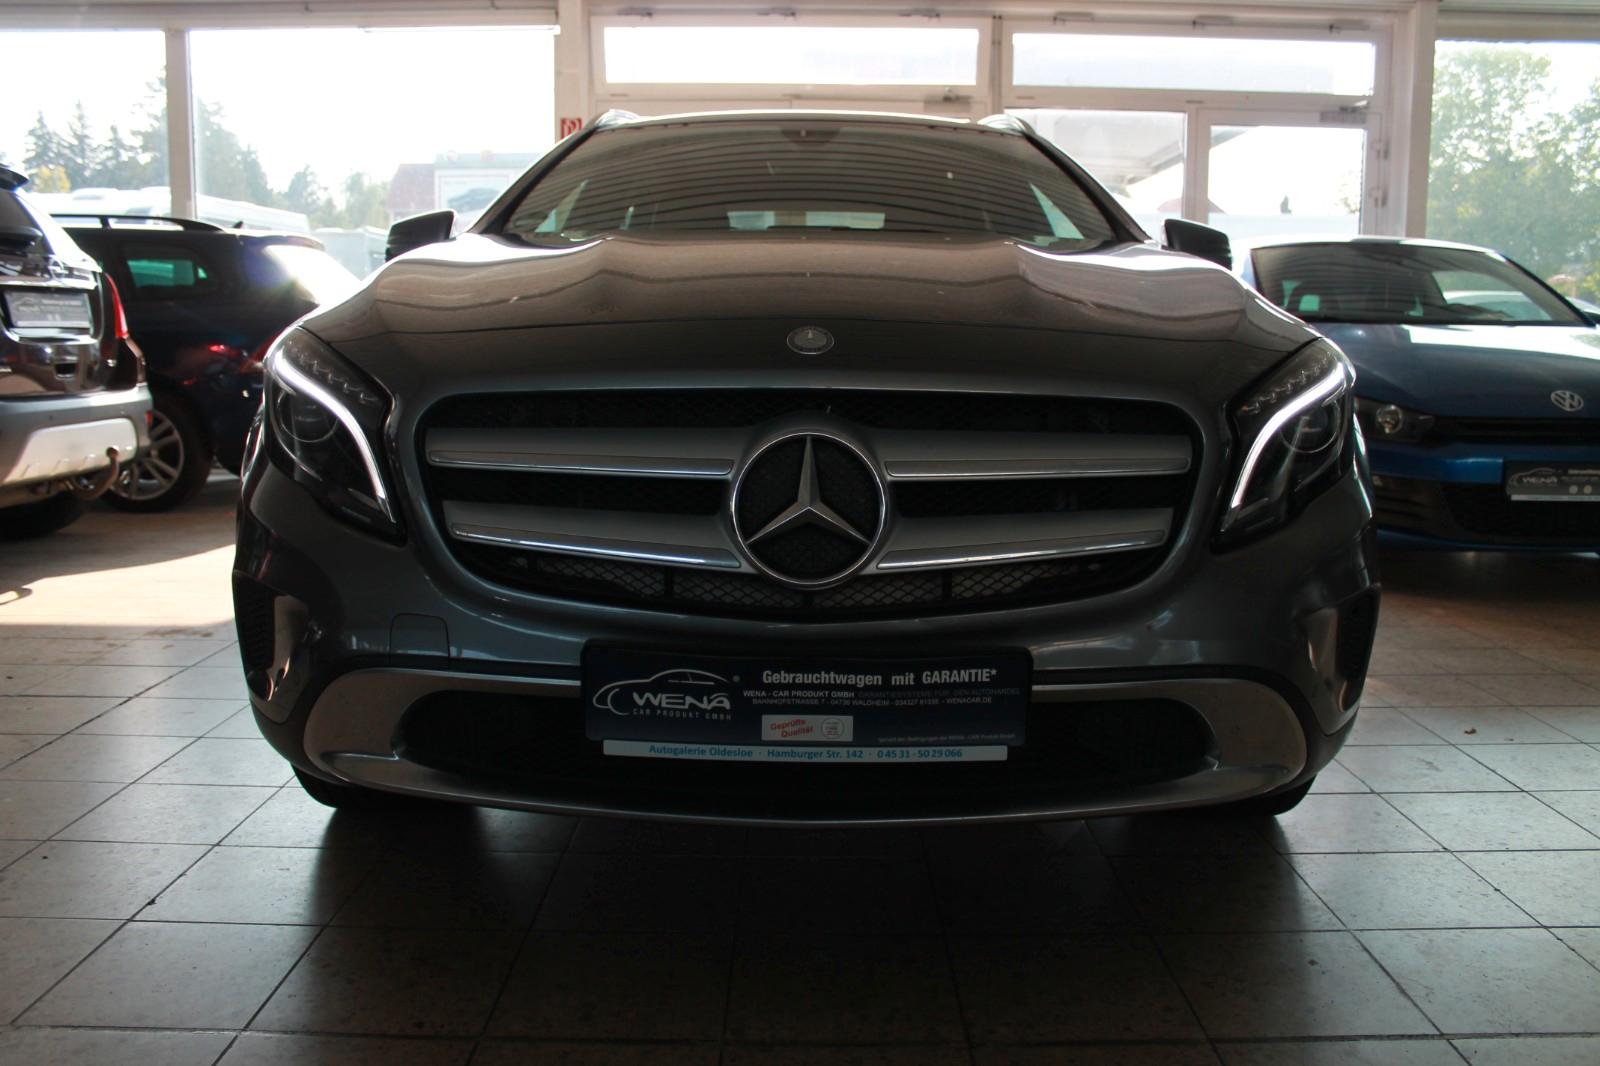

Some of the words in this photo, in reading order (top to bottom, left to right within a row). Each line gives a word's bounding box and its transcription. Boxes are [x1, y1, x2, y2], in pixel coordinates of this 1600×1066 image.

[762, 670, 883, 688] Gebrauchtwagen
[891, 672, 915, 685] mit
[633, 692, 731, 710] WENA
[791, 690, 828, 698] PRODUKT
[649, 744, 705, 757] Autogalerie
[709, 746, 752, 758] Oldesloe
[767, 749, 822, 760] Hamburger
[826, 749, 842, 759] Str.
[847, 749, 863, 759] 142
